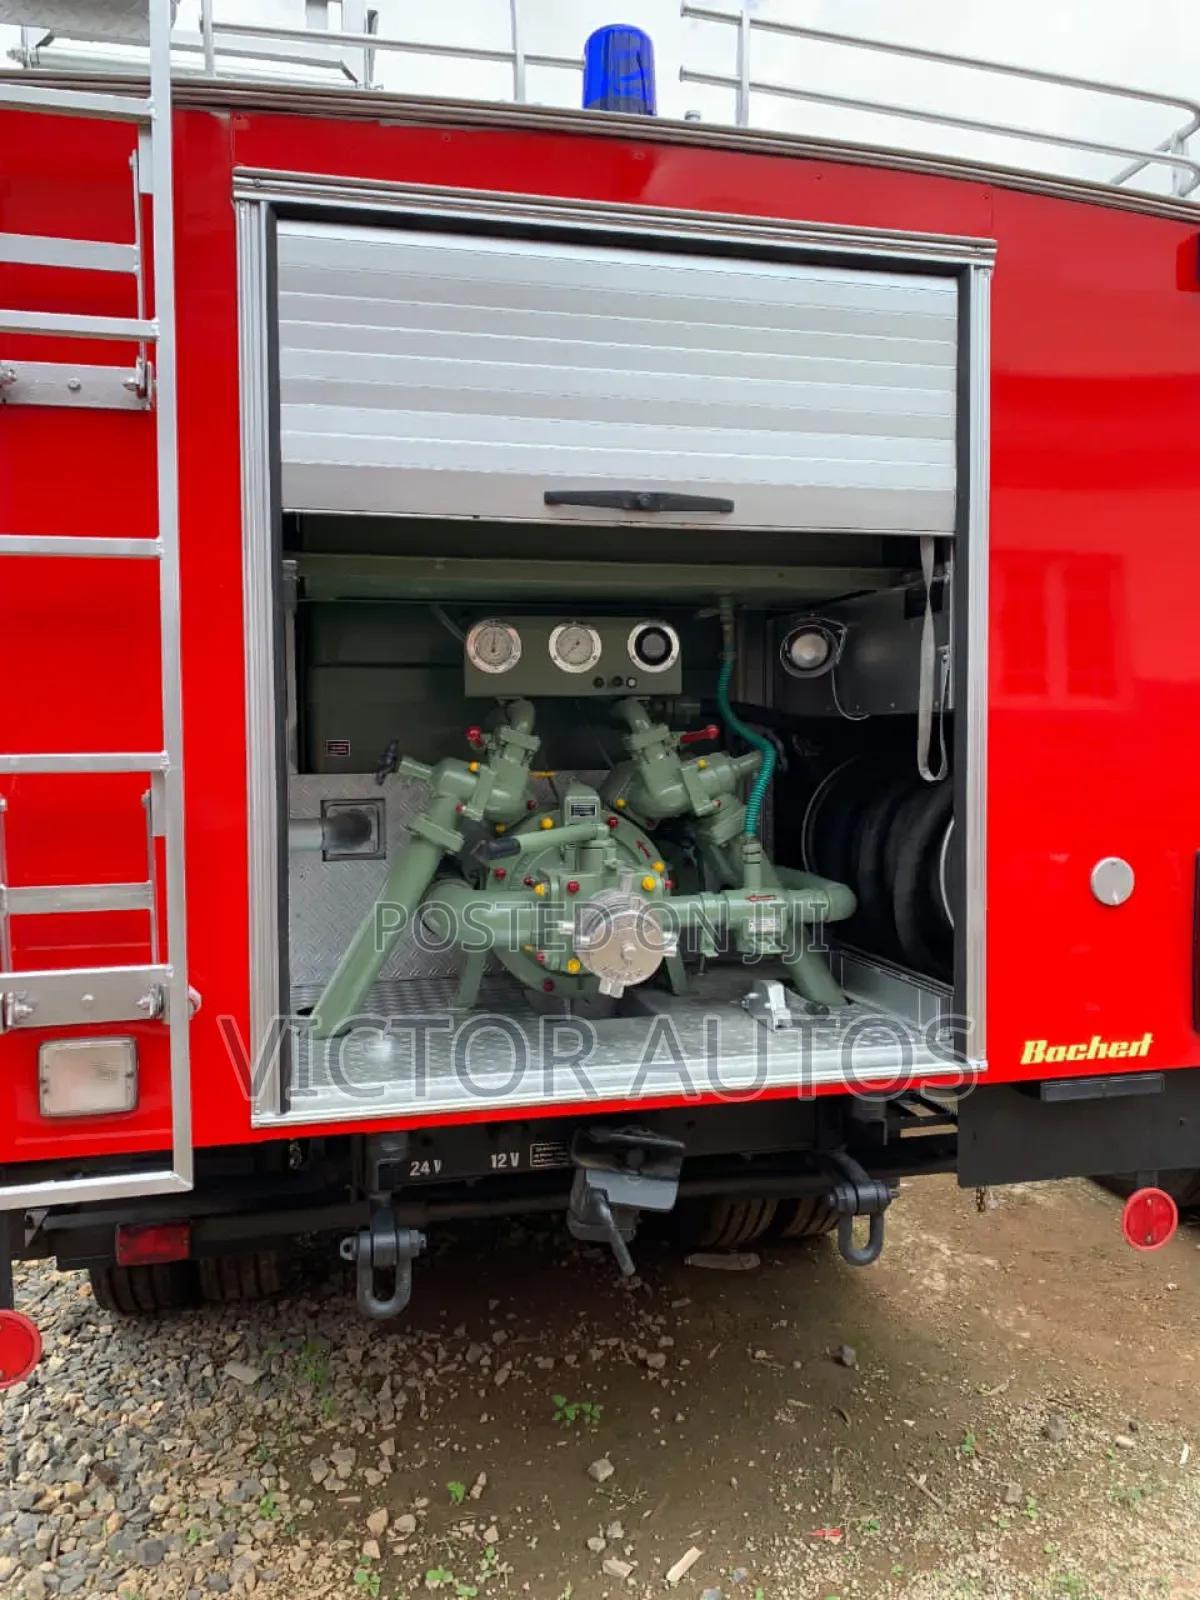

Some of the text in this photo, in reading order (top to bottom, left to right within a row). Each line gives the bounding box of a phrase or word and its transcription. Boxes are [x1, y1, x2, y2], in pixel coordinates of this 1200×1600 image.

[409, 1159, 442, 1177] 24 V
[490, 1153, 507, 1169] 12
[510, 1152, 520, 1168] V
